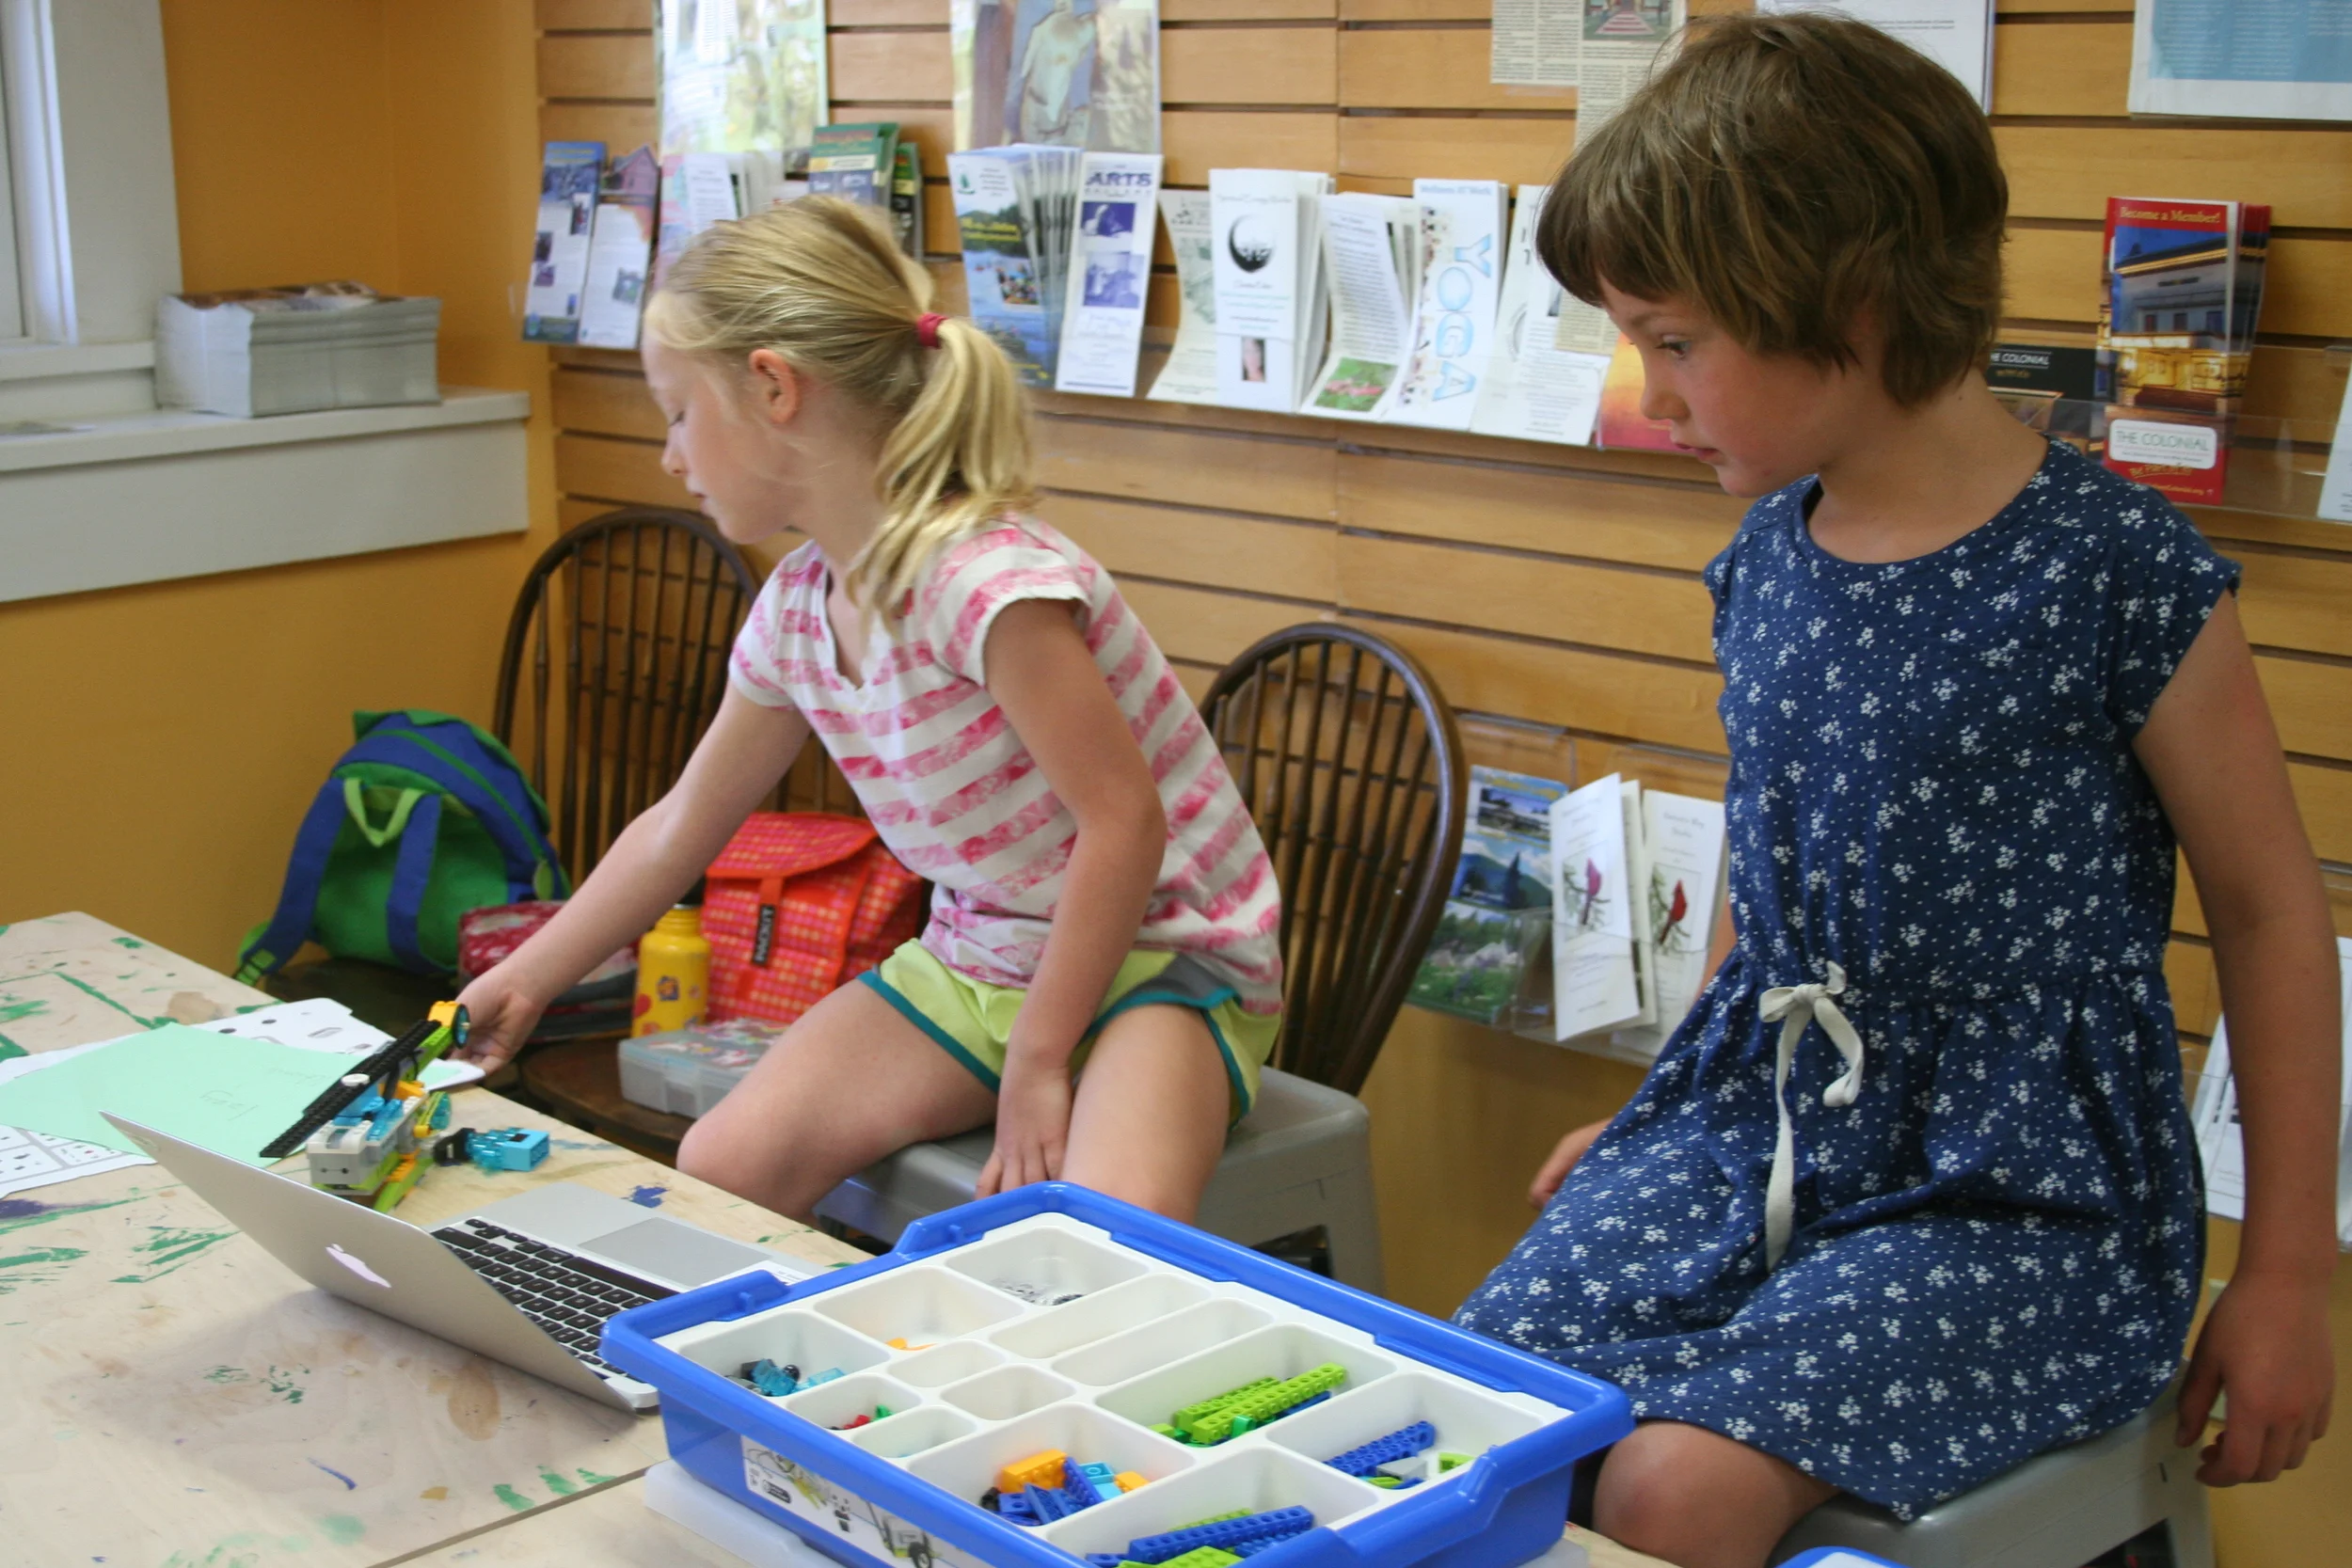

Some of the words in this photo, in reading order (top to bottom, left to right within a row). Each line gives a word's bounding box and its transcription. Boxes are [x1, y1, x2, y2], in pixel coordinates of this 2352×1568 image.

[1084, 172, 1152, 186] ARTS
[2120, 206, 2160, 220] Become
[1432, 234, 1491, 401] YOGA
[2001, 353, 2050, 366] COLONIAL
[2141, 434, 2209, 451] COLONIAL
